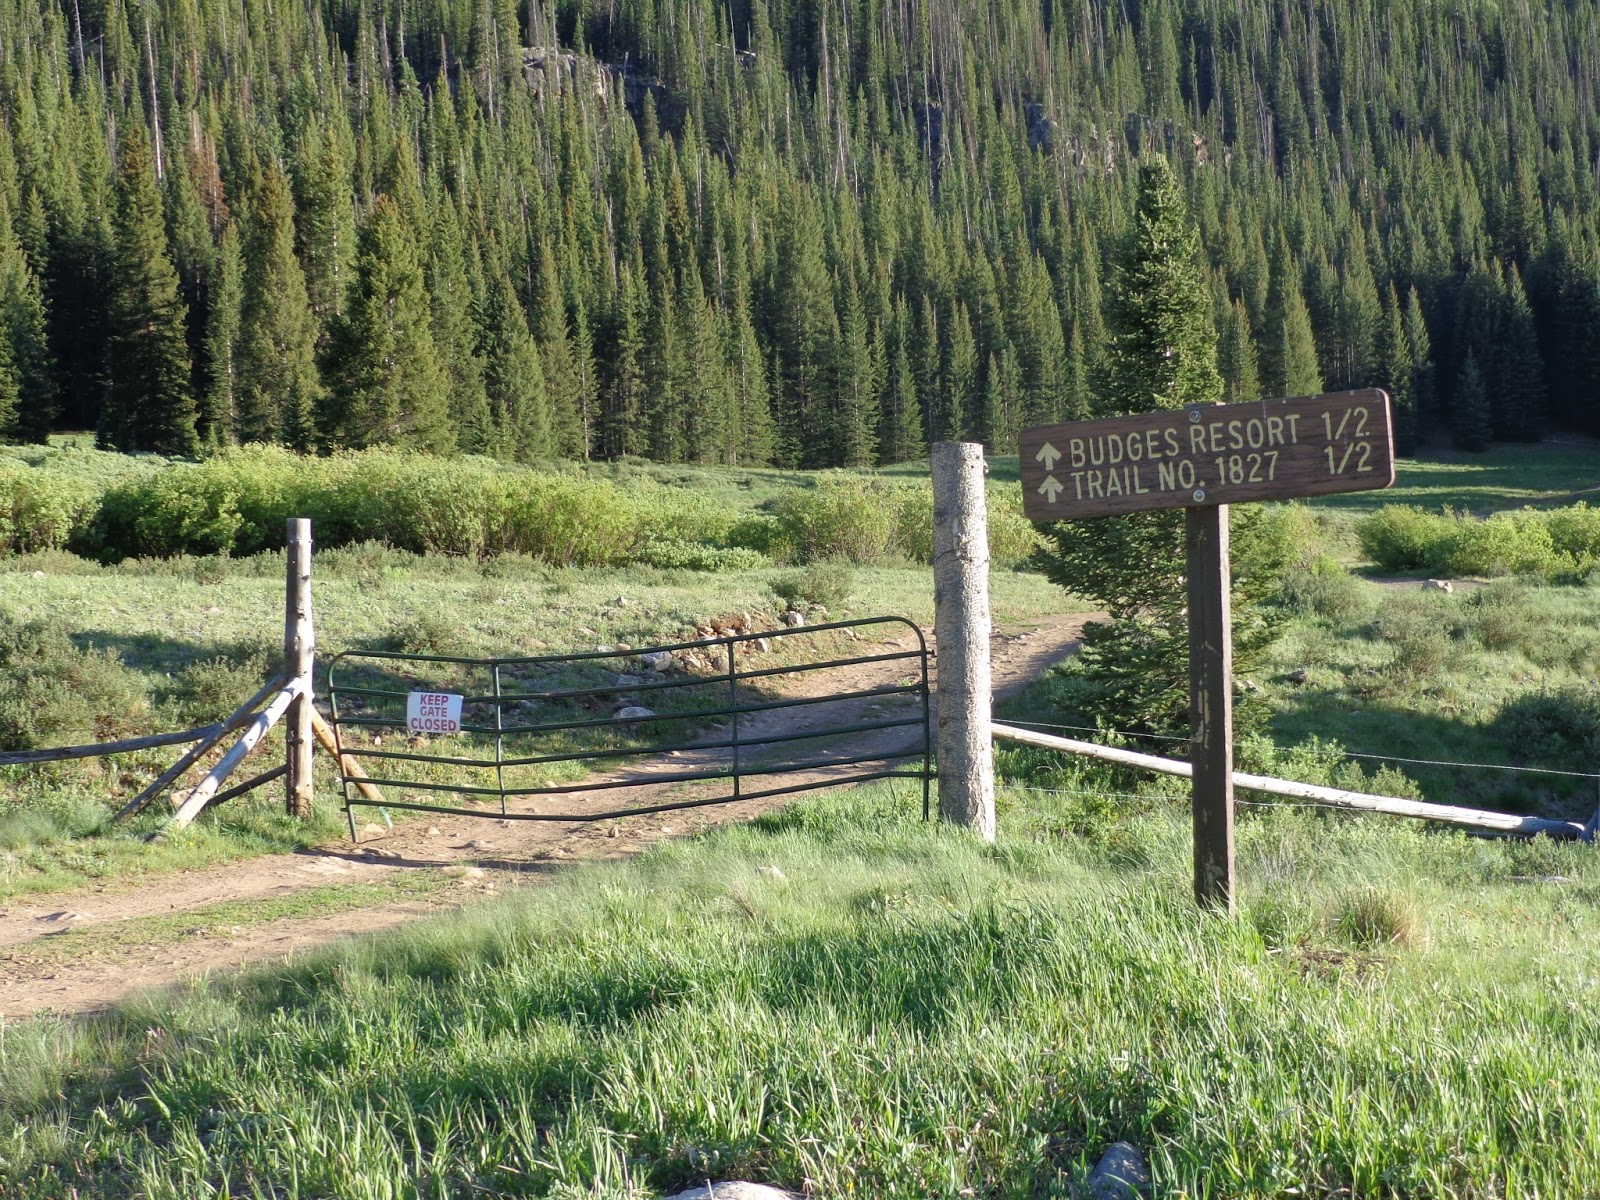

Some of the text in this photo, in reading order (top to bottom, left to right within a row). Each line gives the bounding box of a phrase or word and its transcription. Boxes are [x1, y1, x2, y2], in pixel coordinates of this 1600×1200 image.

[1069, 407, 1370, 468] BUDGES RESORT 1/2
[1070, 441, 1373, 500] TRAIL NO. 1827 1/2
[420, 694, 449, 706] KEEP
[420, 706, 448, 717] GATE
[411, 717, 457, 731] CLOSED
